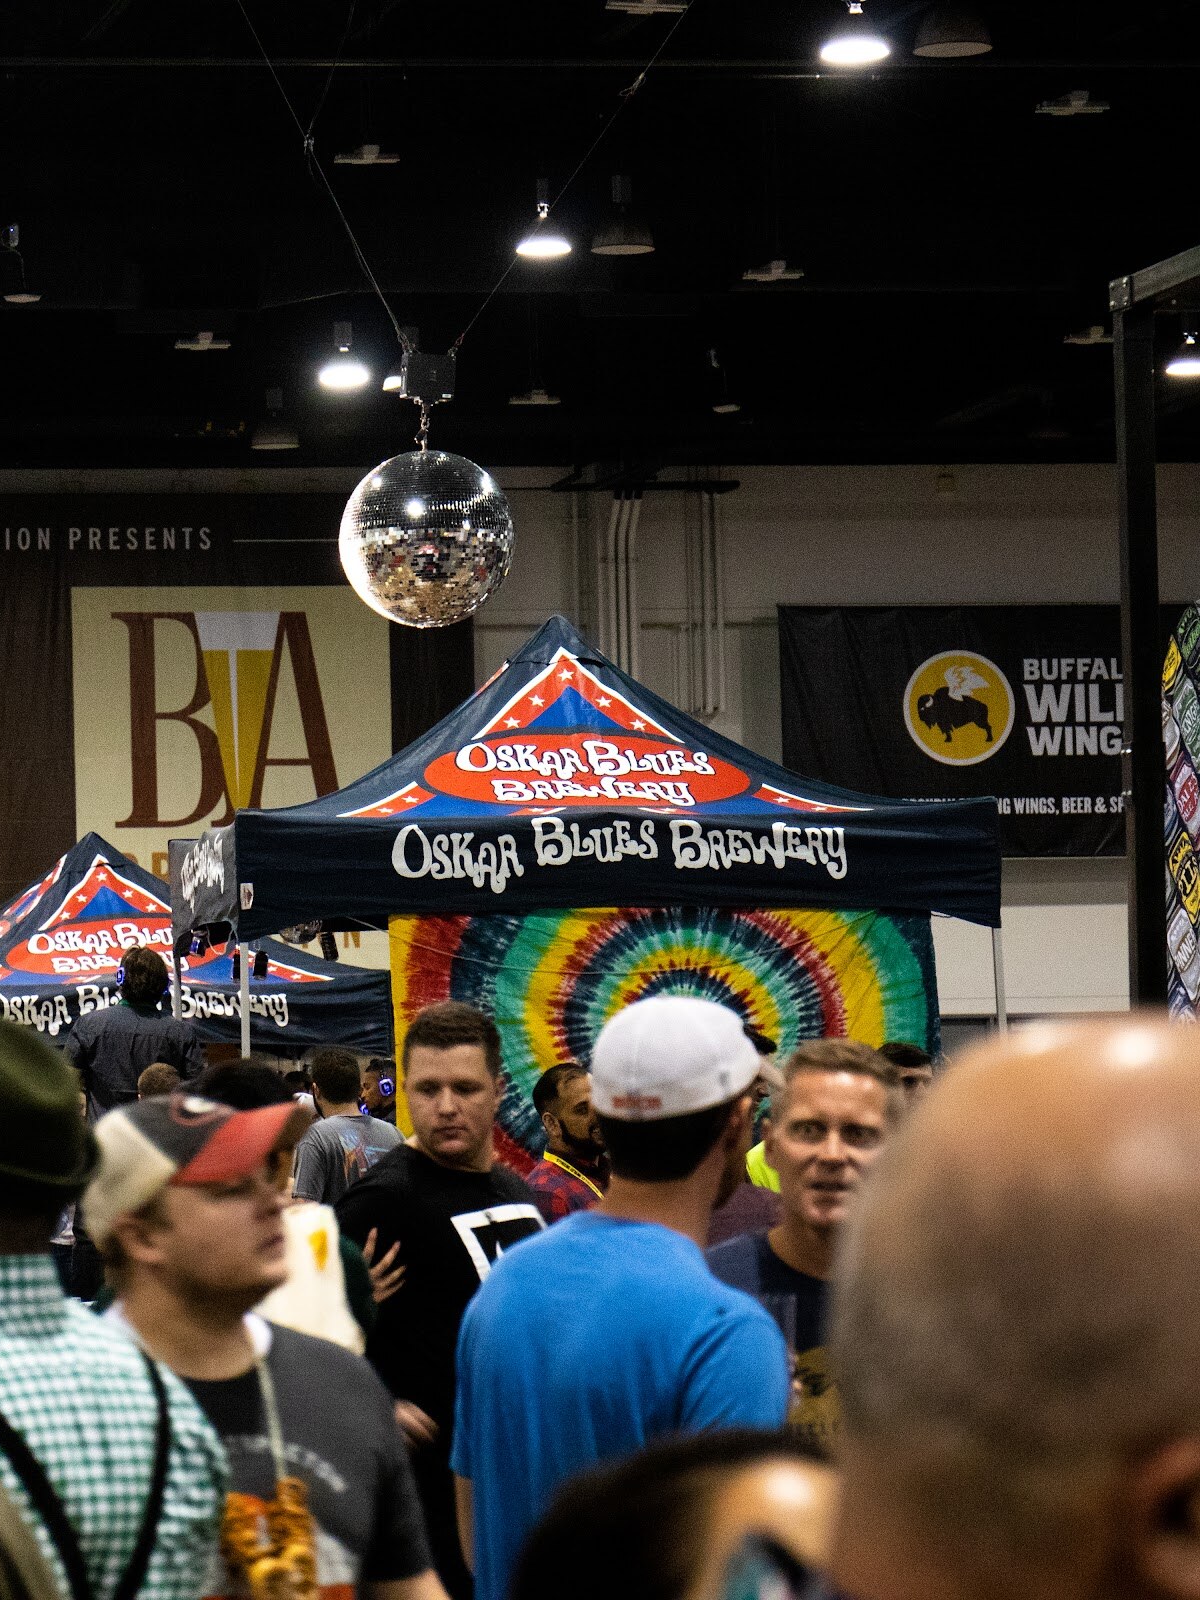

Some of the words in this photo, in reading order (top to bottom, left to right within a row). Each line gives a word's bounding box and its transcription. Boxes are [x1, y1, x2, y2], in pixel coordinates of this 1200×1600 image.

[68, 527, 212, 550] PRESENTS
[1023, 657, 1124, 681] BUFFAL
[1026, 725, 1123, 756] WING
[456, 740, 589, 780] OSKAR
[584, 740, 716, 776] BLUES
[491, 775, 695, 806] BREWERY
[1062, 797, 1092, 814] BEER
[1094, 797, 1108, 814] &
[391, 823, 525, 893] OSKAR
[531, 816, 659, 866] BLUES
[669, 818, 848, 880] BREWERY
[26, 929, 118, 955] OSKAR
[113, 922, 174, 949] BLU
